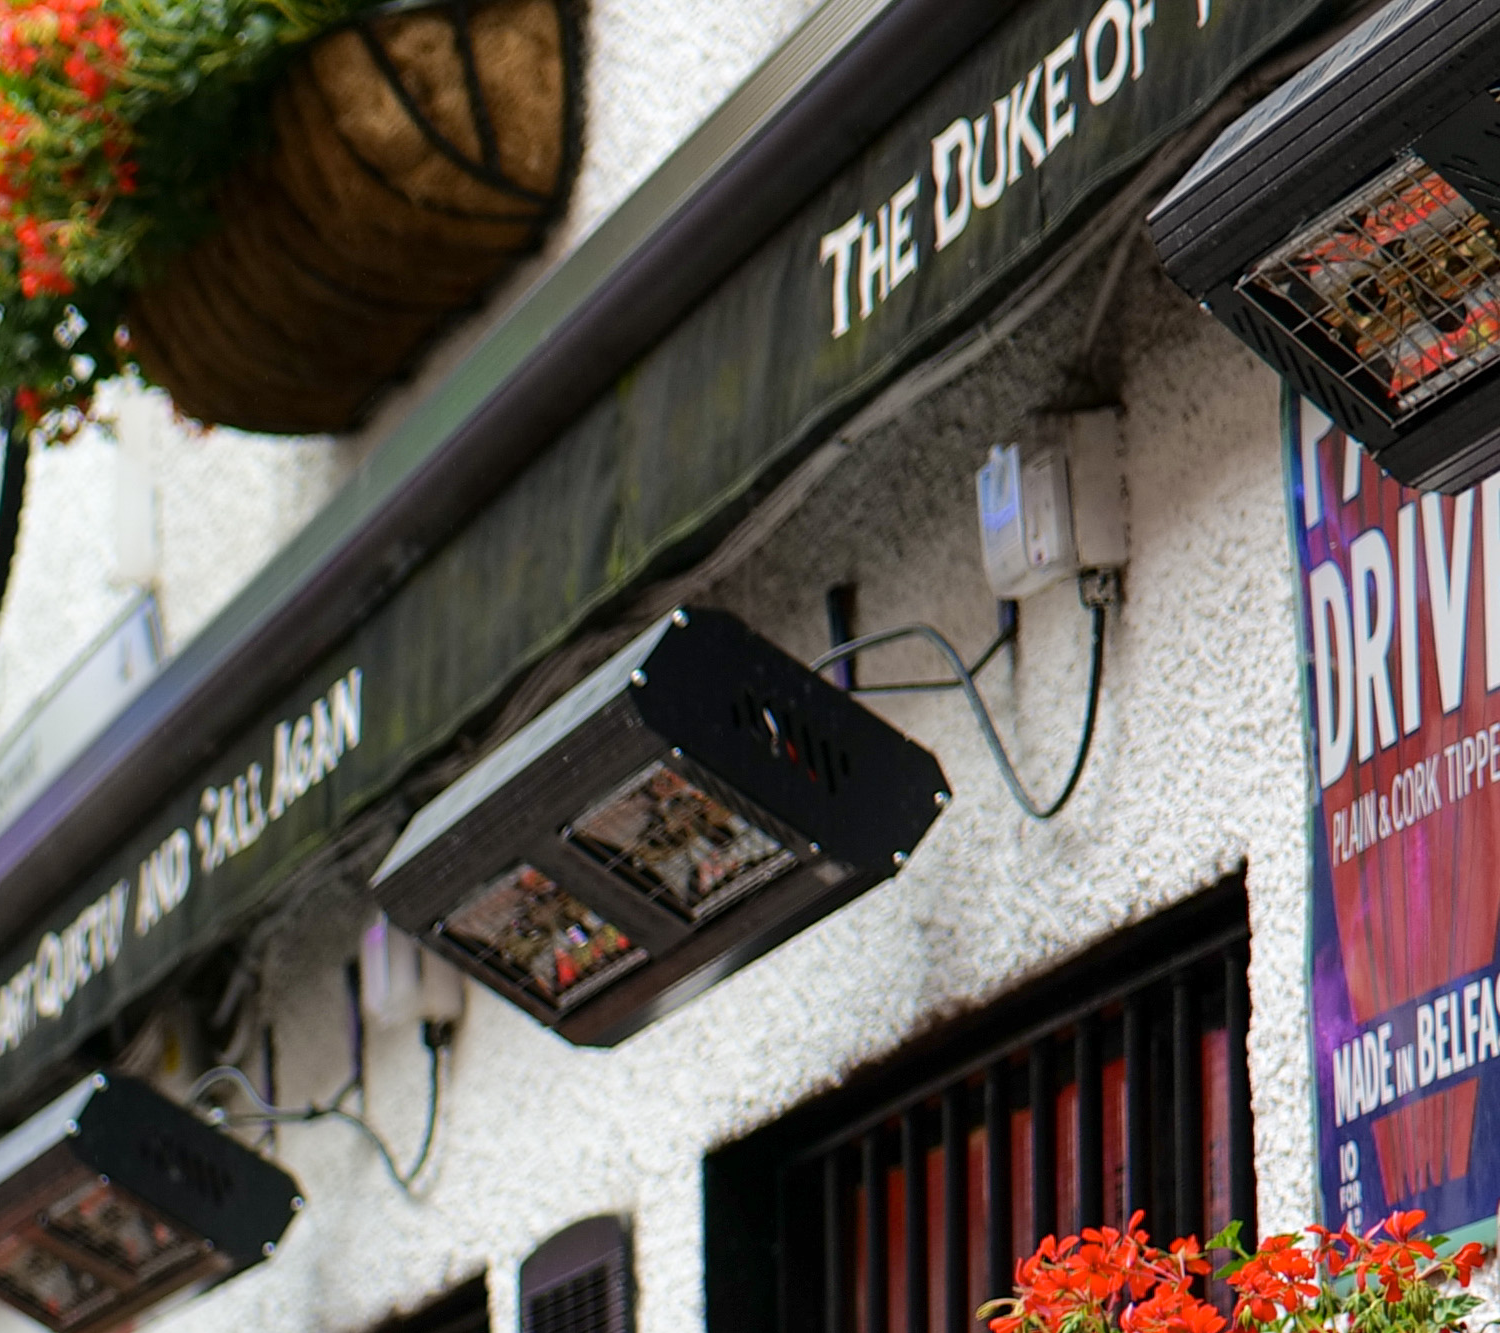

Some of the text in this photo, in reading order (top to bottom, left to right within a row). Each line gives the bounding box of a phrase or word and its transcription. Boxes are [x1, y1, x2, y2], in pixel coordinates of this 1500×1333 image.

[819, 0, 1156, 340] THE DUKE OF
[1332, 788, 1378, 868] PLAIN
[1378, 793, 1394, 840] &
[1391, 752, 1443, 832] CORK
[1332, 1021, 1396, 1128] MADE
[1395, 1043, 1416, 1098] IN
